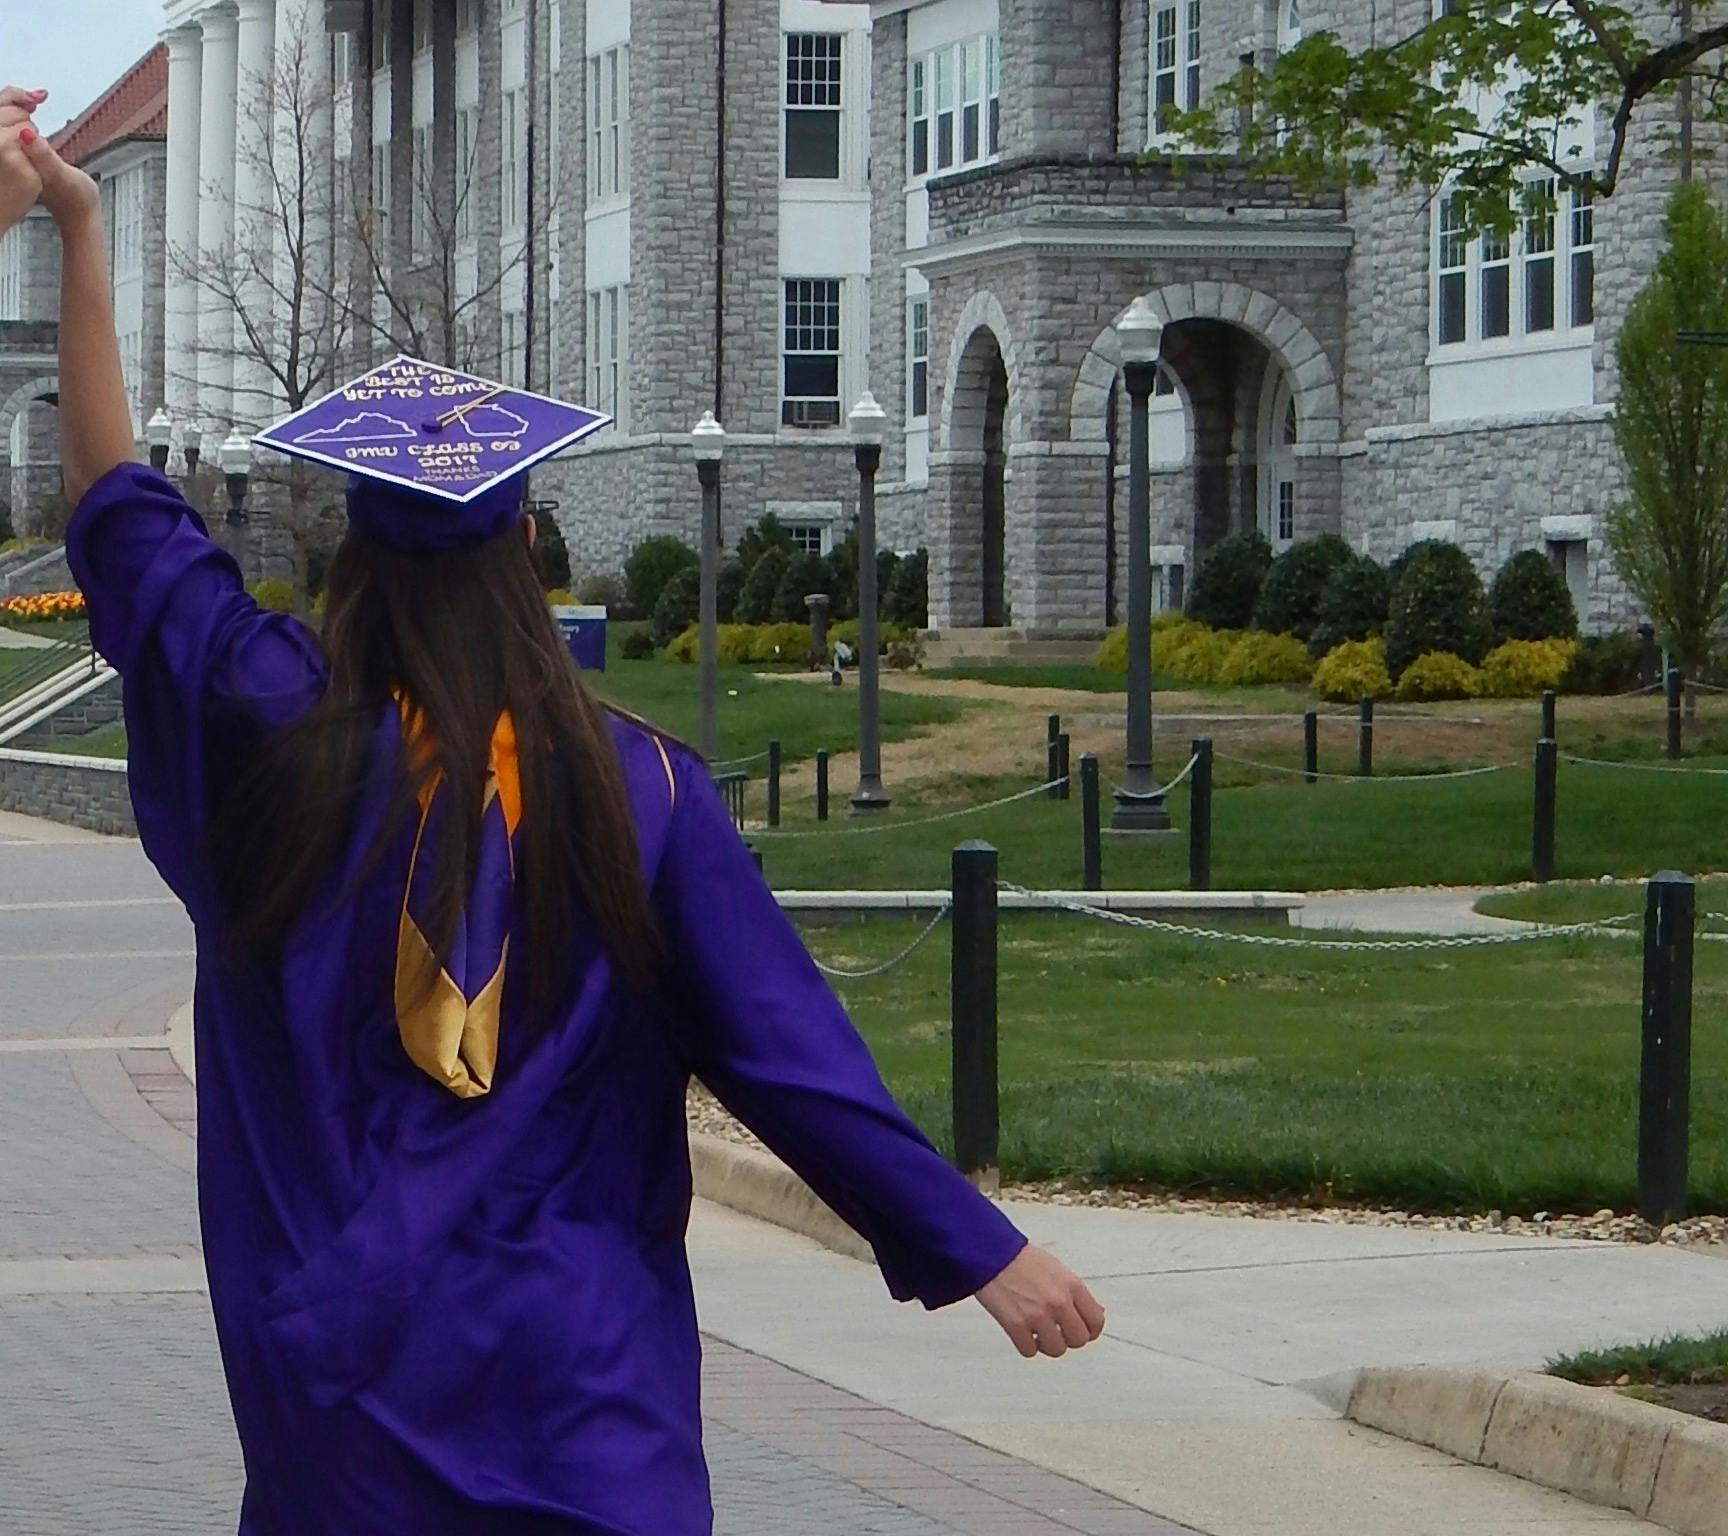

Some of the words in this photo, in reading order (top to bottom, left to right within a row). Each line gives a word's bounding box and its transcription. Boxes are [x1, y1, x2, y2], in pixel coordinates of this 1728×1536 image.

[383, 365, 432, 377] THE
[365, 376, 424, 387] BEST
[430, 374, 455, 384] IS
[343, 388, 387, 401] YET
[390, 388, 423, 399] TO
[429, 383, 495, 396] COME
[345, 446, 398, 458] JMU
[407, 443, 483, 455] CLASS
[490, 440, 522, 452] OF
[417, 455, 478, 468] 2017
[423, 465, 481, 475] THANKS
